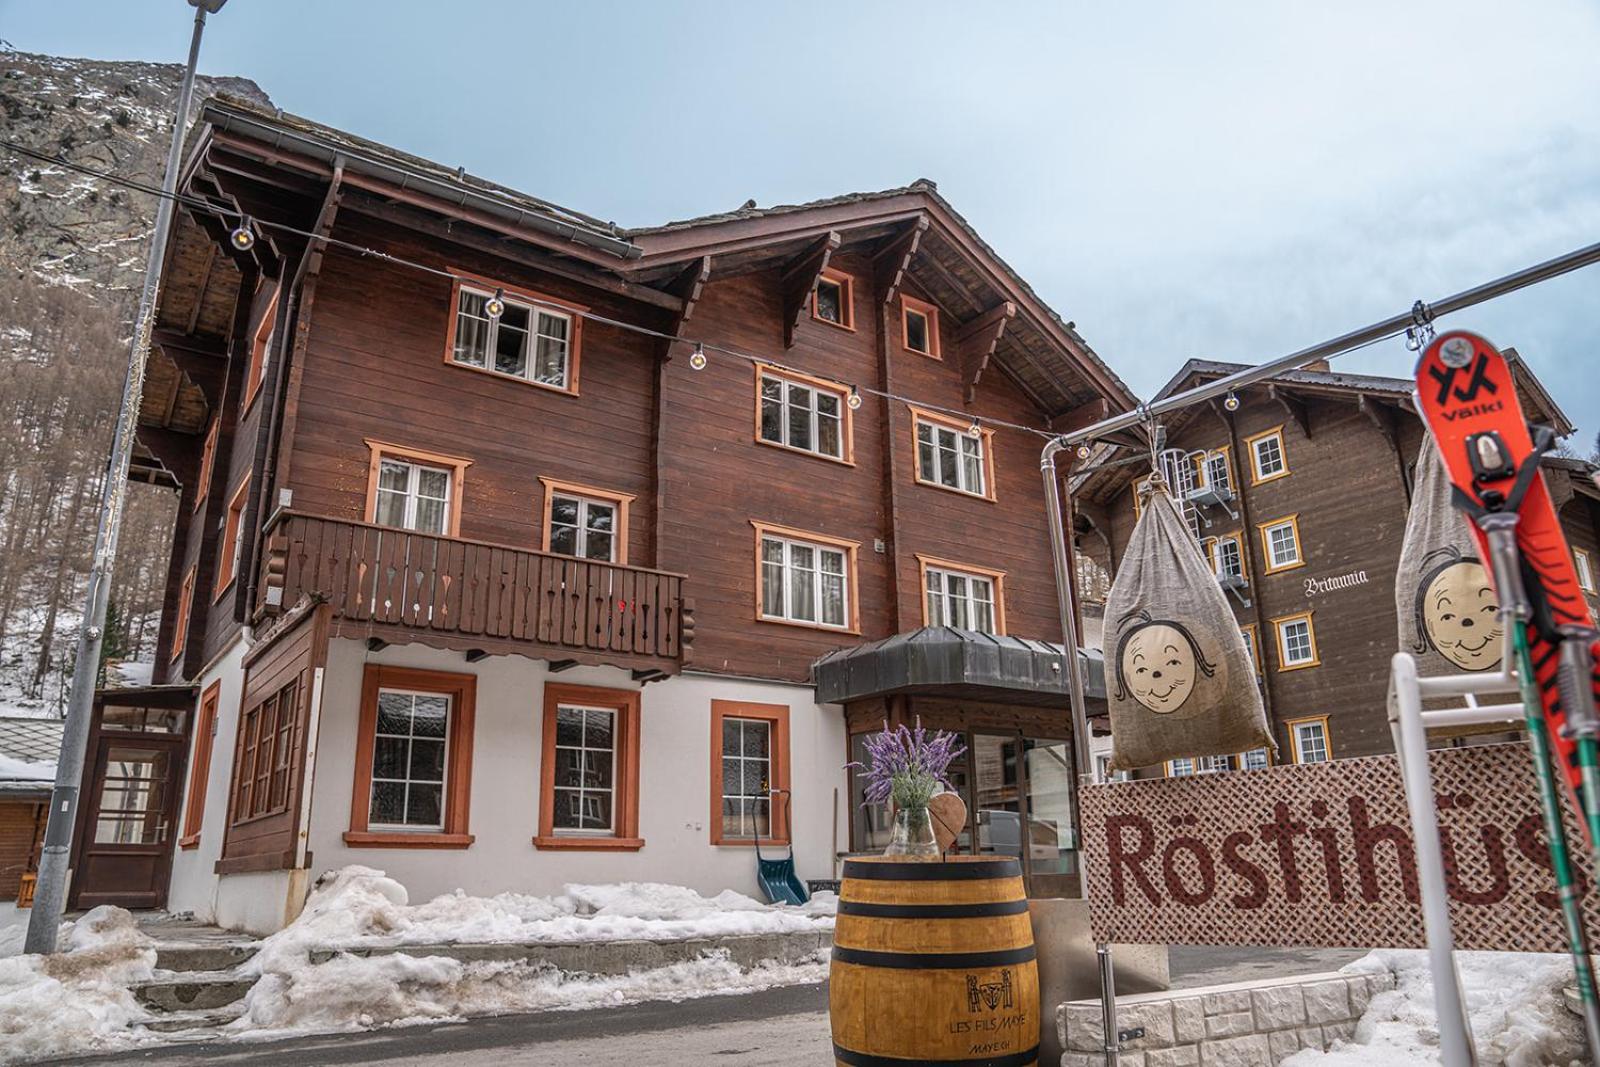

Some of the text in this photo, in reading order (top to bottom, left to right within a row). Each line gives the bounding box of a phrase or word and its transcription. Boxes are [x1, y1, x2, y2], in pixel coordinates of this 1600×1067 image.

[1303, 570, 1369, 597] Britannia
[950, 1014, 1025, 1034] LES FILS MAYE
